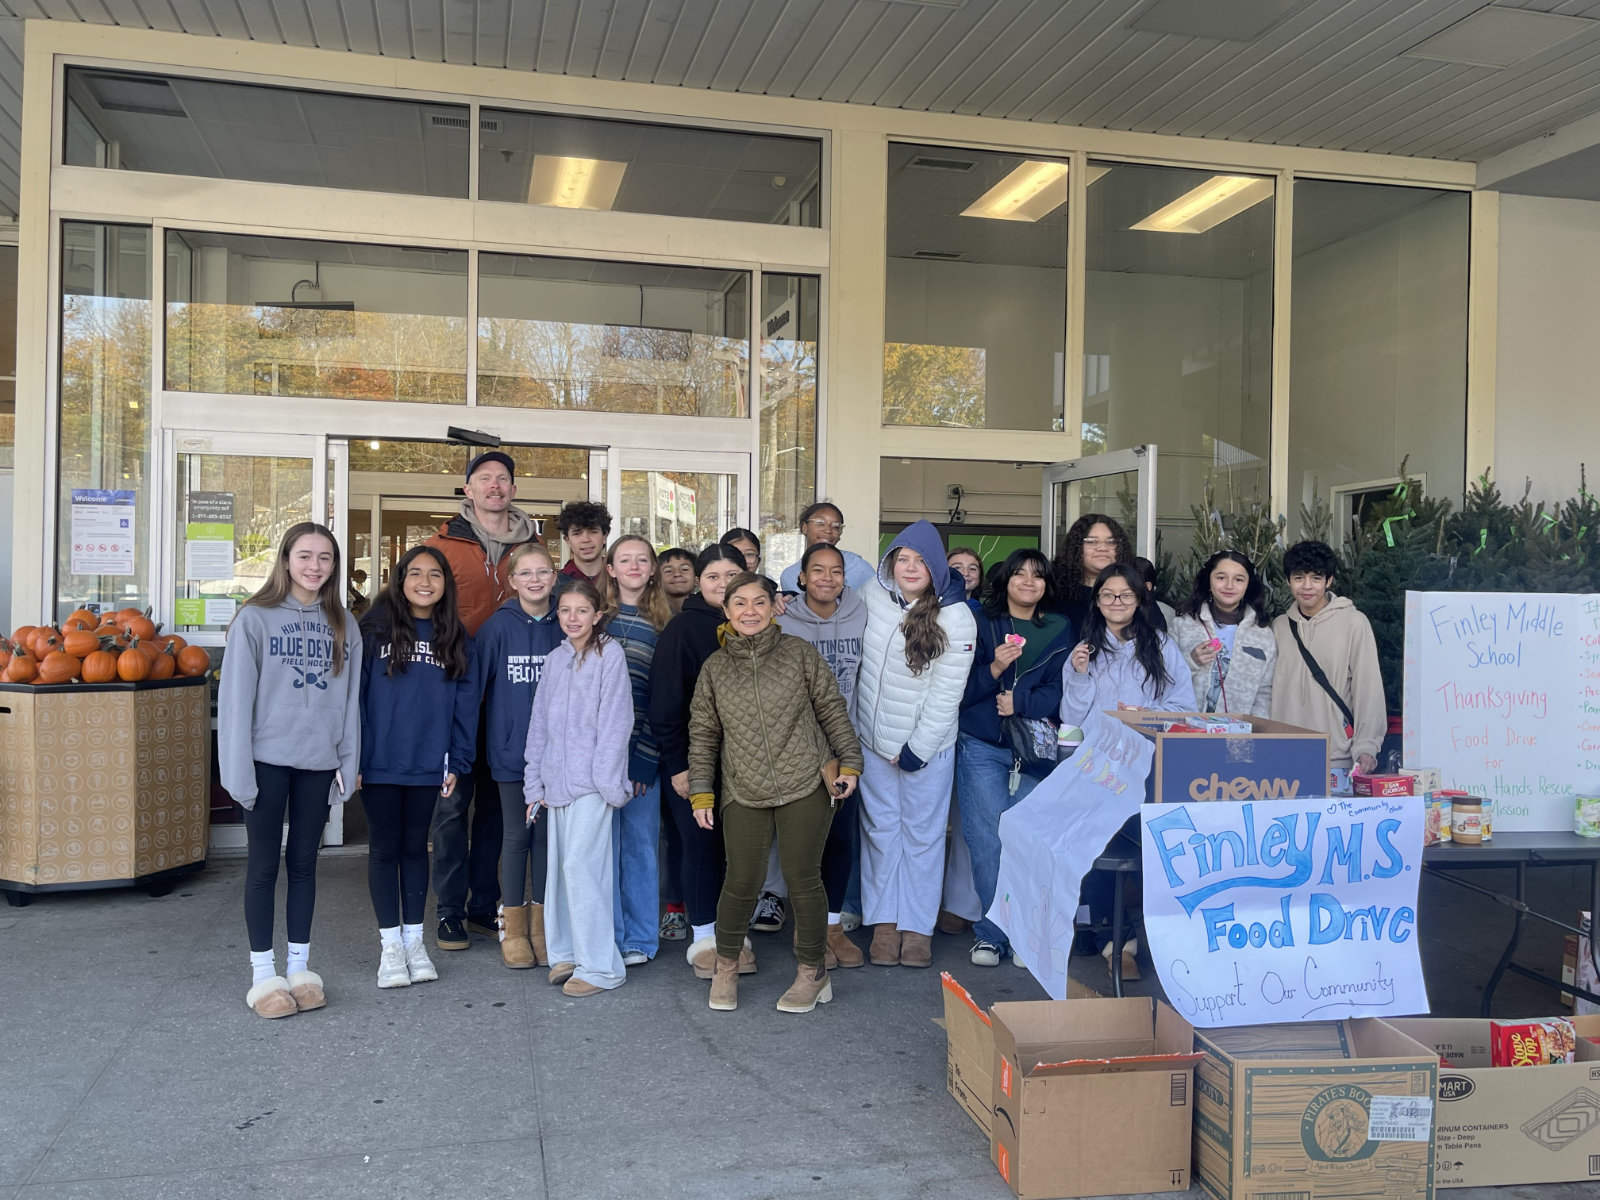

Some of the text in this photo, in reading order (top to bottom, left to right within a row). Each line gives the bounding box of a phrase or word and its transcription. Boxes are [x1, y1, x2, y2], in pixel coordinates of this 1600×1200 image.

[1429, 602, 1564, 645] Finley Middle
[269, 636, 350, 662] BLUE DEVS
[1467, 640, 1522, 668] School
[307, 660, 334, 669] HOCKE
[1435, 682, 1548, 720] Thanksgiving
[1451, 725, 1538, 752] Food Drive
[1188, 772, 1300, 801] chewy
[1382, 786, 1407, 796] GIORGIO
[1494, 774, 1533, 796] Hands
[1539, 775, 1574, 797] Rescue
[1338, 801, 1353, 811] The
[1349, 801, 1389, 817] Community
[1146, 804, 1412, 892] Finley M.S.
[1200, 893, 1414, 953] Food Drive
[1171, 956, 1395, 1022] Support Our Community
[1511, 1032, 1534, 1067] Stove
[1524, 1037, 1540, 1059] Top
[1304, 1087, 1346, 1122] PIRATE'S
[1349, 1087, 1371, 1112] BOO
[1462, 1123, 1509, 1132] CONTAINERS
